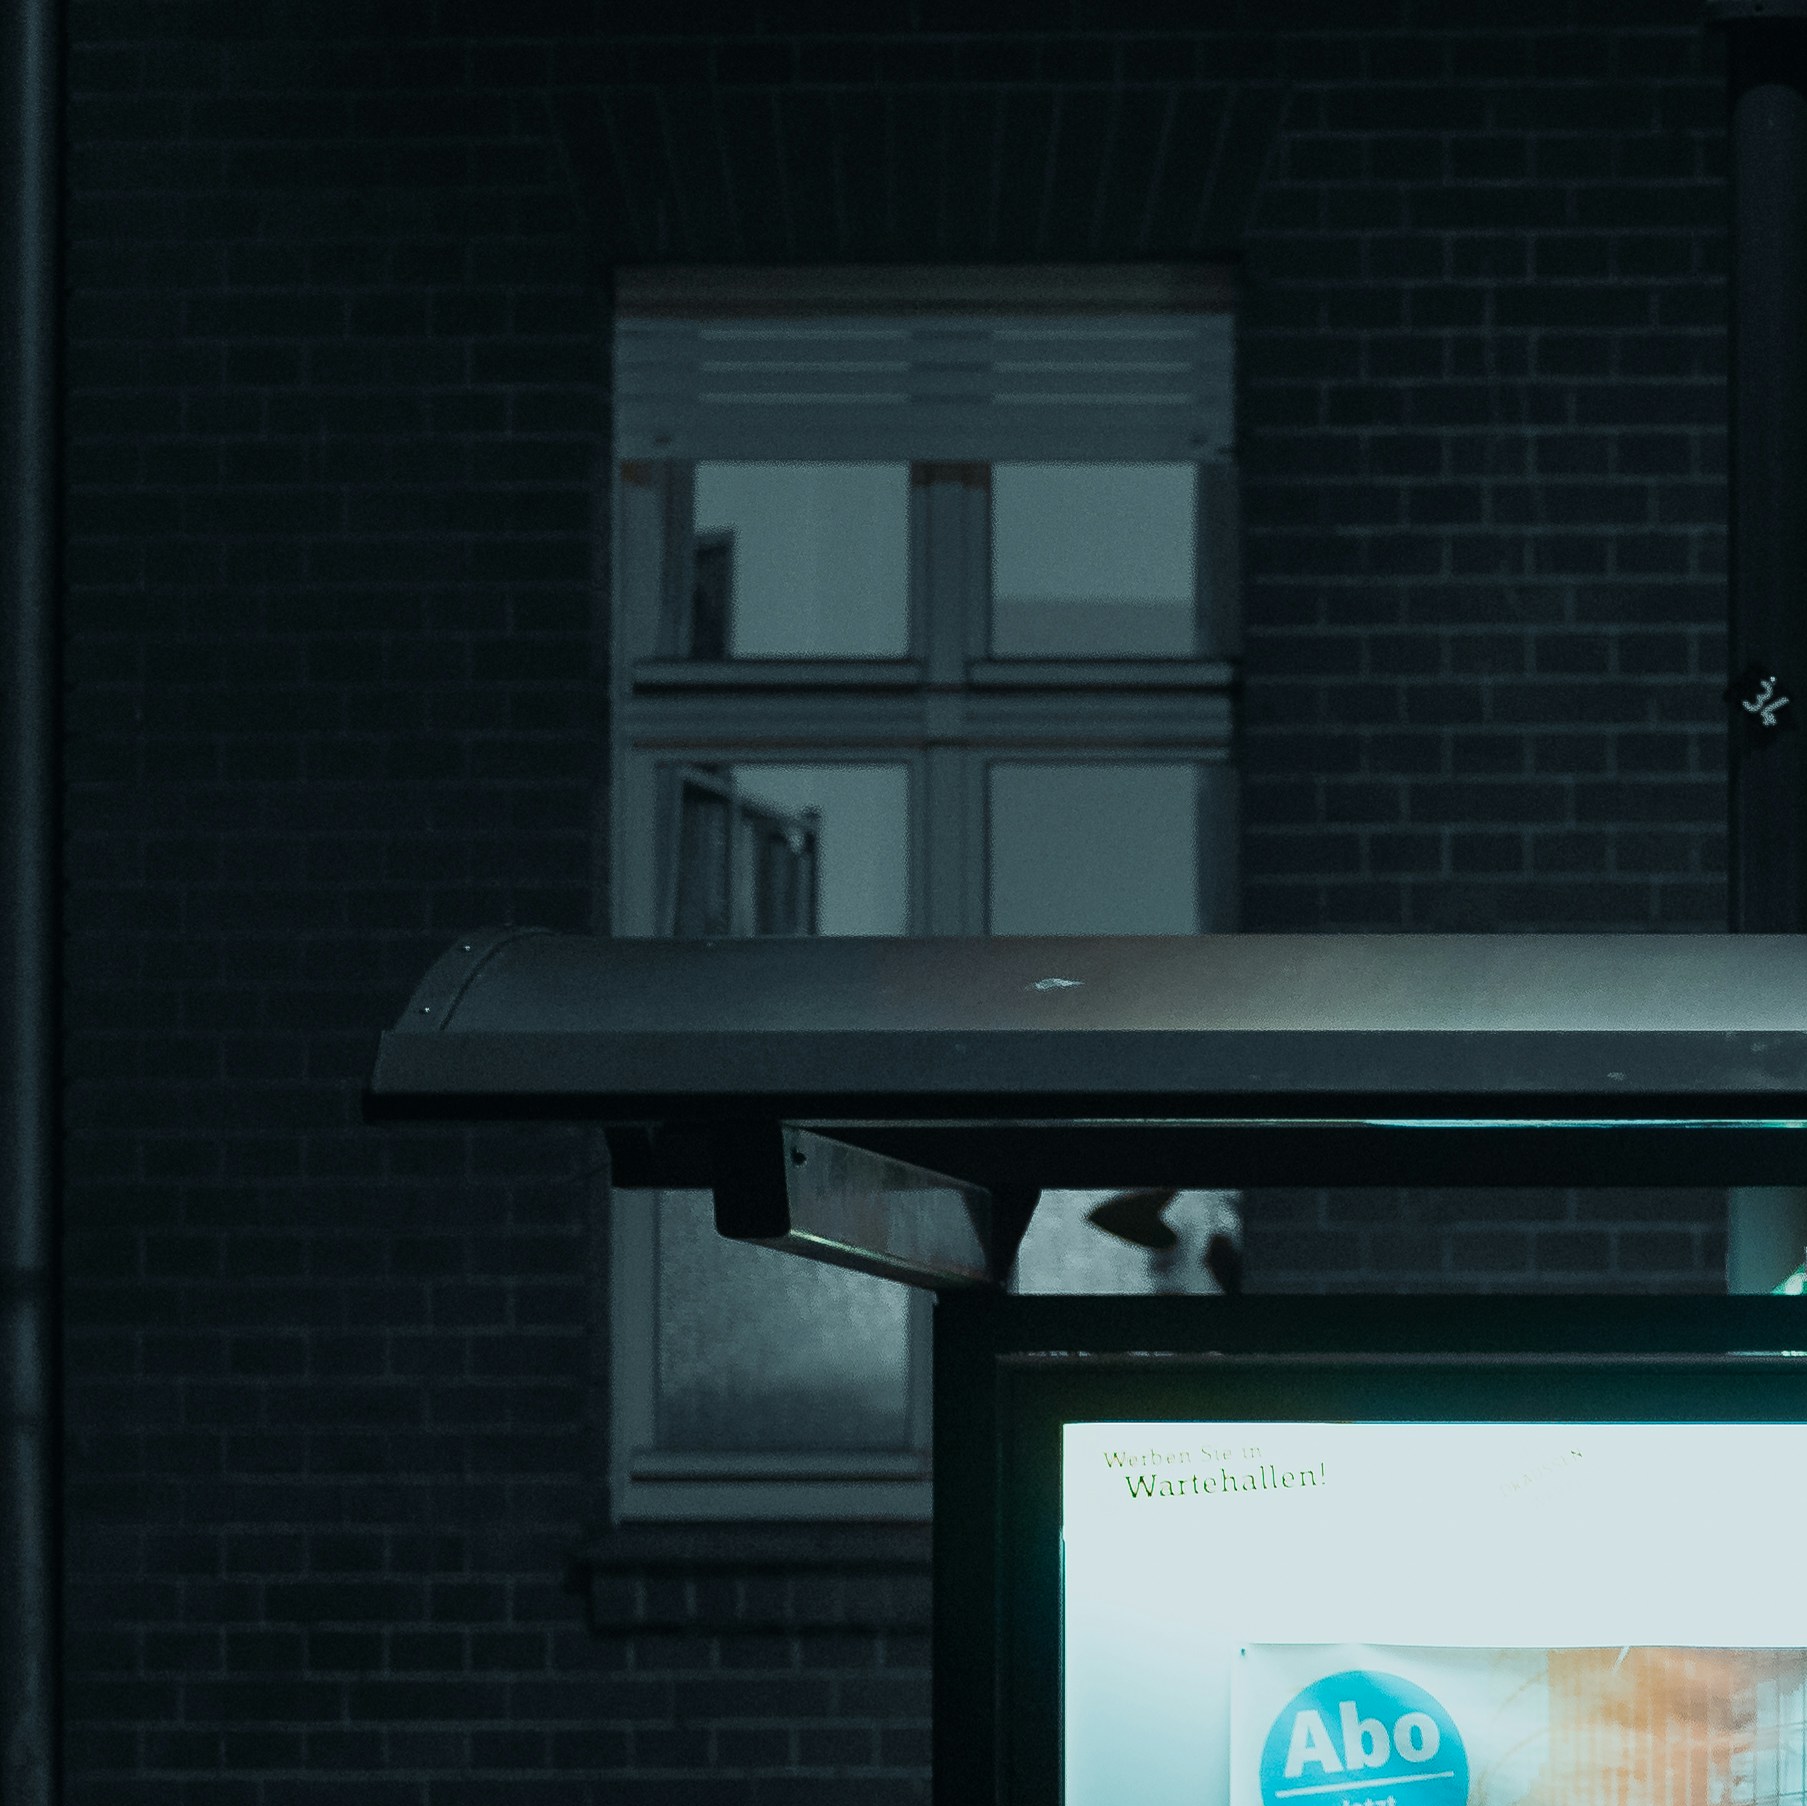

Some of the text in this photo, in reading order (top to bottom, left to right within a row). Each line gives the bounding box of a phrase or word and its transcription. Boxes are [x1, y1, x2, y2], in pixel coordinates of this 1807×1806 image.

[1741, 676, 1791, 728] 34
[1103, 1448, 1192, 1469] Werben
[1200, 1445, 1232, 1463] Sie
[1125, 1462, 1327, 1499] Wartehallen!
[1284, 1700, 1441, 1778] Abo
